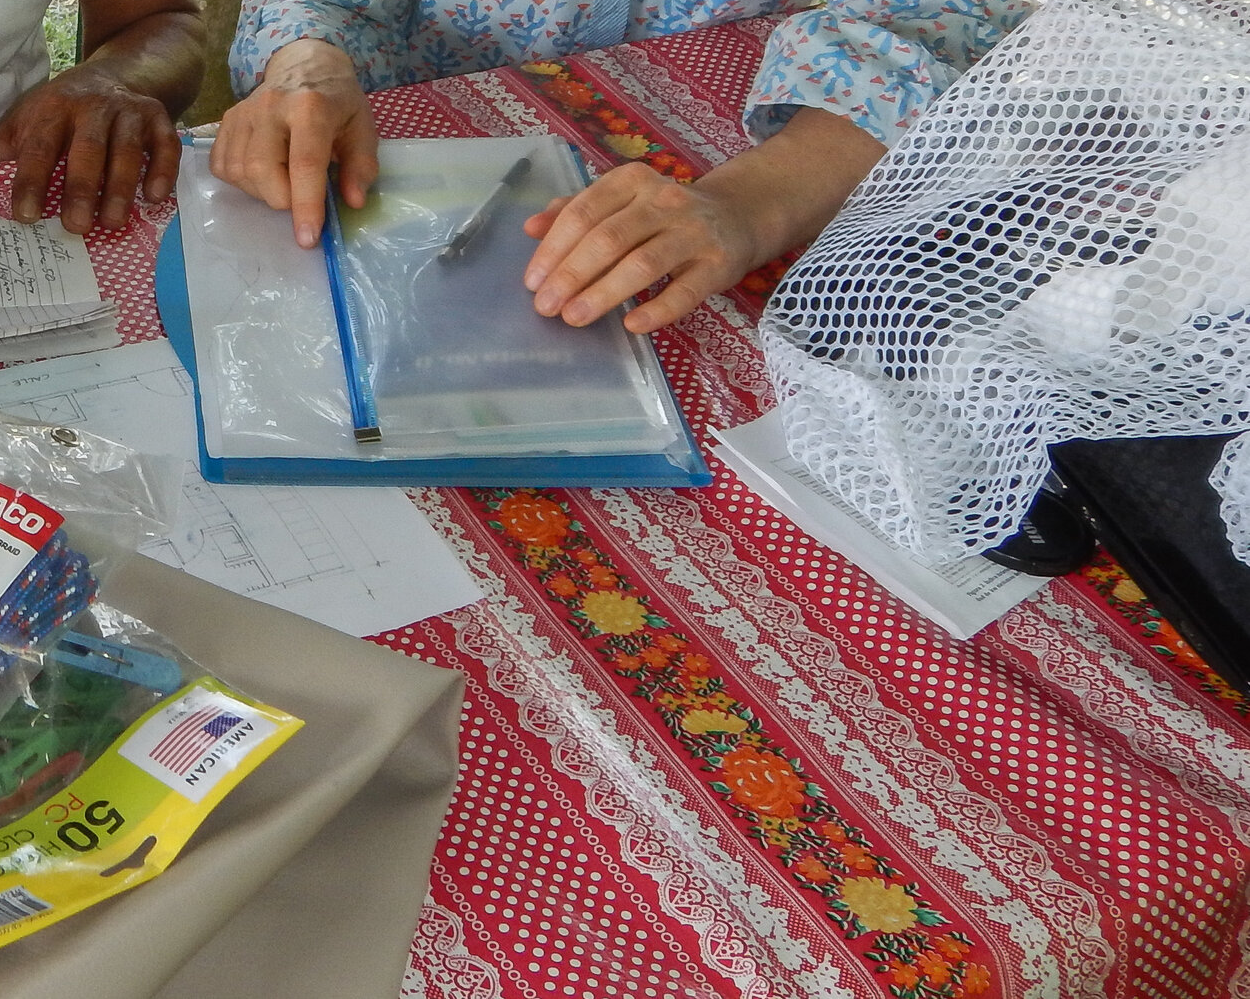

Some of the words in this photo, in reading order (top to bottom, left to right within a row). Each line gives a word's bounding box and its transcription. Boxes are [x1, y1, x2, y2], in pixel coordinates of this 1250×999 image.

[186, 722, 254, 786] AMERICAN
[44, 792, 85, 823] PC
[57, 800, 126, 852] 50
